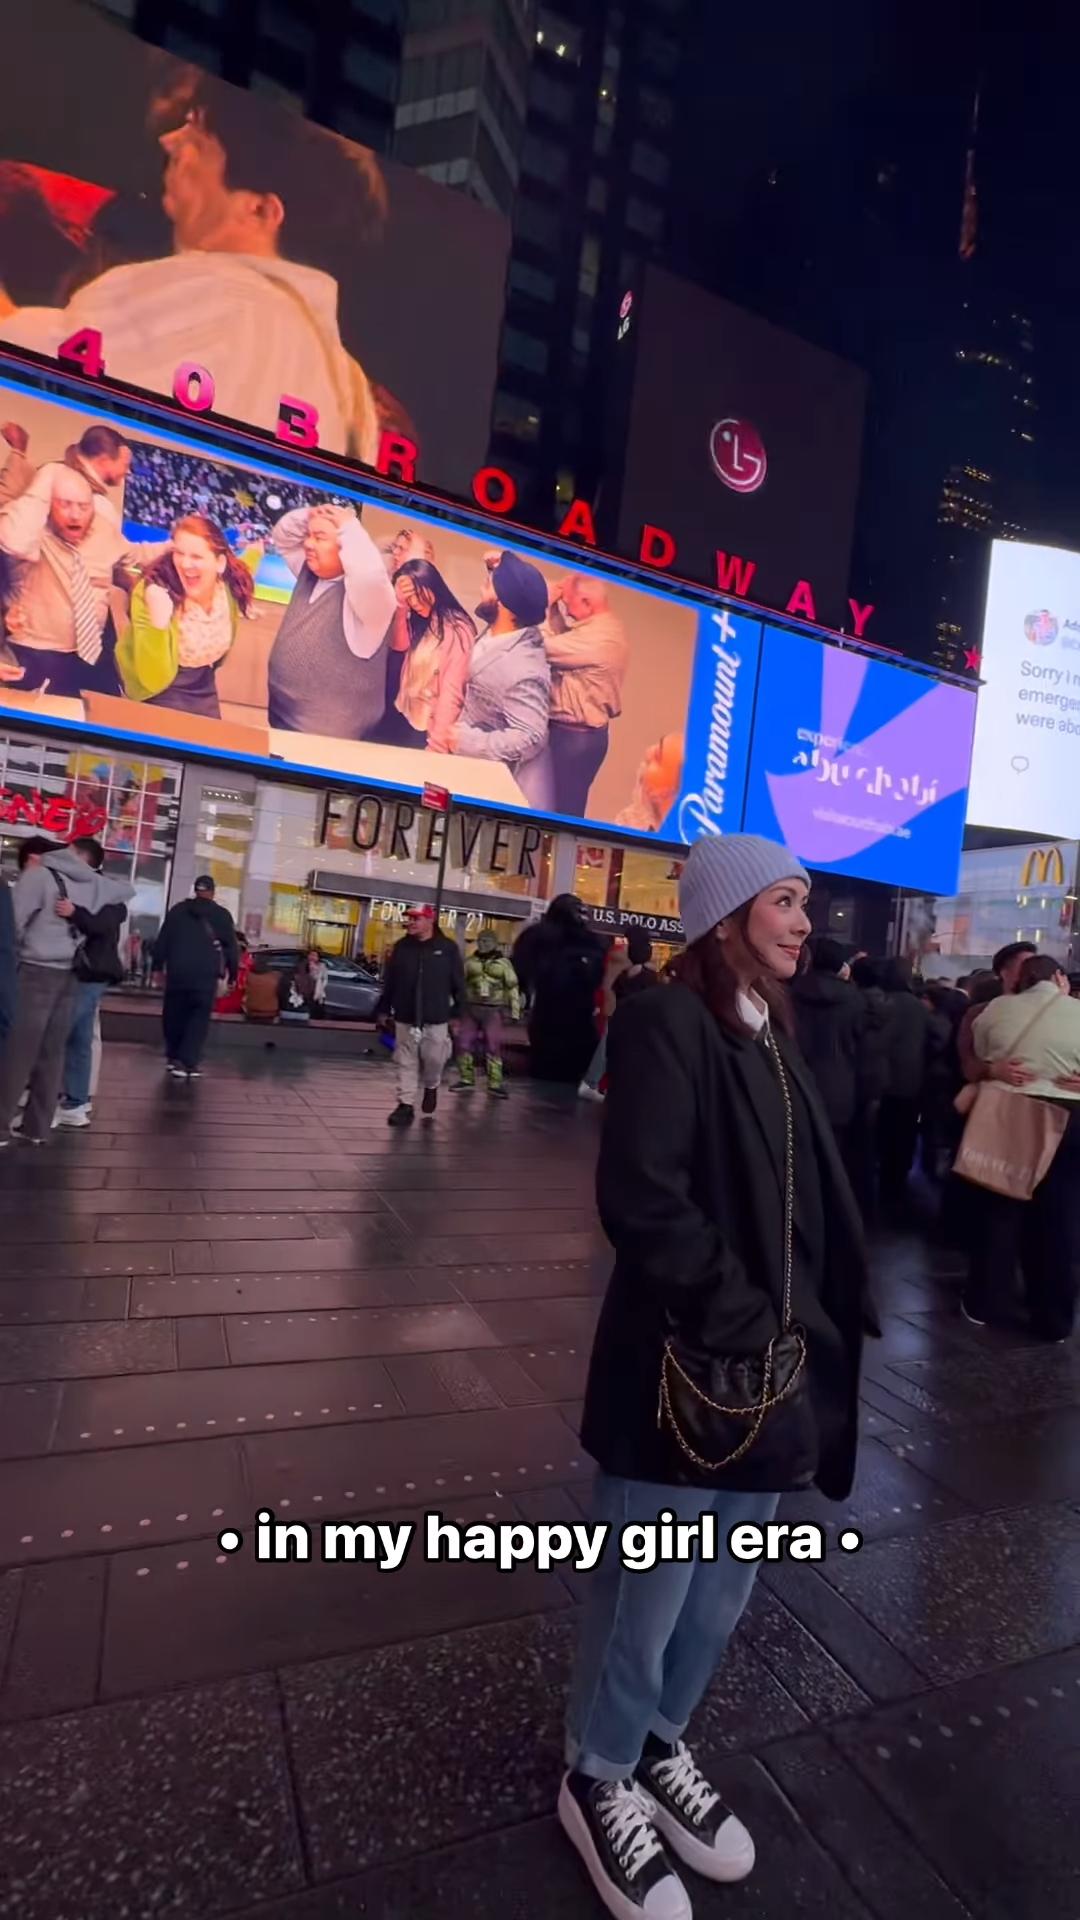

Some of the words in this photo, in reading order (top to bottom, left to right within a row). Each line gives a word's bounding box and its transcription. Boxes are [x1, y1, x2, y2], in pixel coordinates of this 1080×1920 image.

[275, 392, 876, 637] BROADWAY
[1020, 660, 1064, 685] Sorry
[1016, 713, 1056, 730] were
[317, 789, 541, 878] FOREVER
[465, 911, 485, 932] 21
[592, 908, 616, 925] U.S.
[620, 912, 657, 930] POLO
